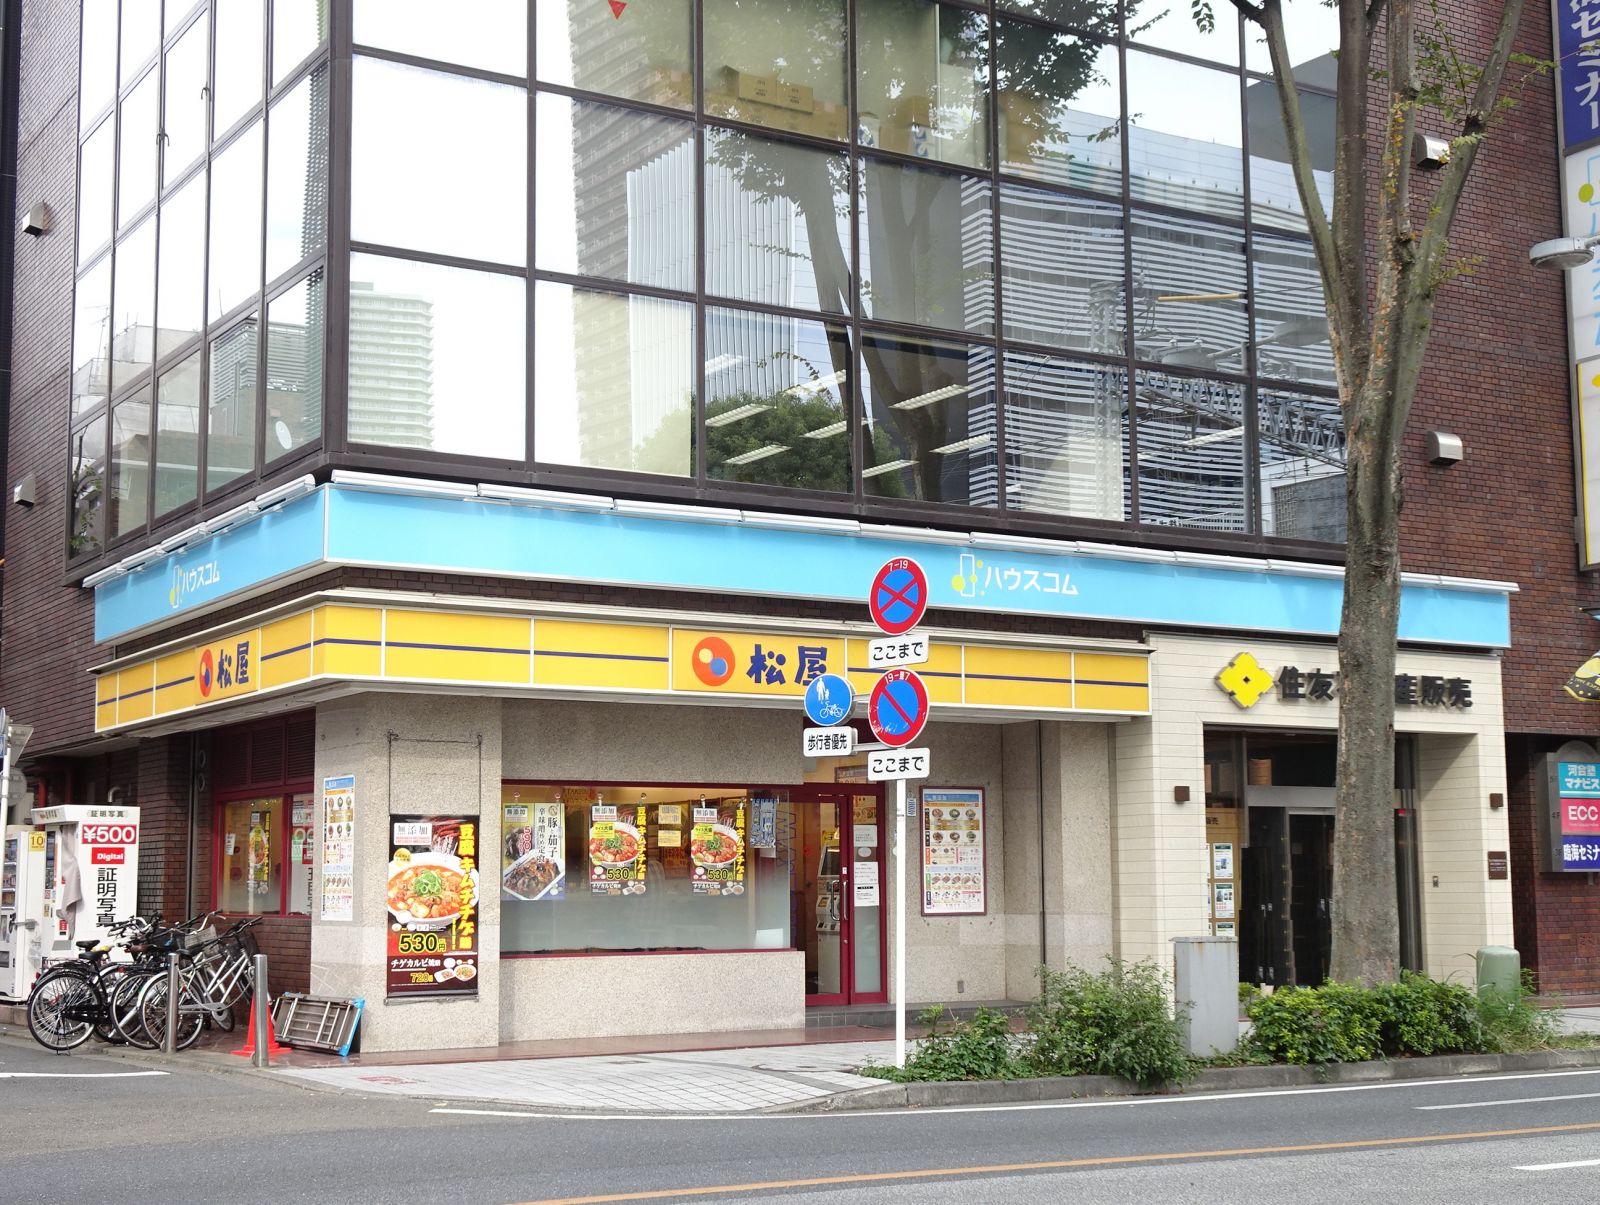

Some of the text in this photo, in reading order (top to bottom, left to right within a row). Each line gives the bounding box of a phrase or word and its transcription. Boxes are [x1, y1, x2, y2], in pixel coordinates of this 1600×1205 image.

[887, 559, 909, 572] 7-19
[181, 560, 221, 594] ハウスコム
[985, 565, 1079, 595] ハウスコム
[873, 641, 924, 661] ここまで
[217, 640, 249, 688] 松屋
[746, 643, 828, 686] 松屋
[1276, 665, 1473, 708] 住友産販売
[807, 733, 848, 751] 歩行者優先
[872, 755, 924, 774] ここまで
[1567, 764, 1596, 776] 河合塾
[1565, 778, 1600, 790] マナビス
[91, 810, 125, 818] 証明写真
[1568, 805, 1599, 821] ECC
[83, 826, 136, 843] ¥500
[97, 852, 124, 862] Digital
[96, 867, 118, 928] 証明写真
